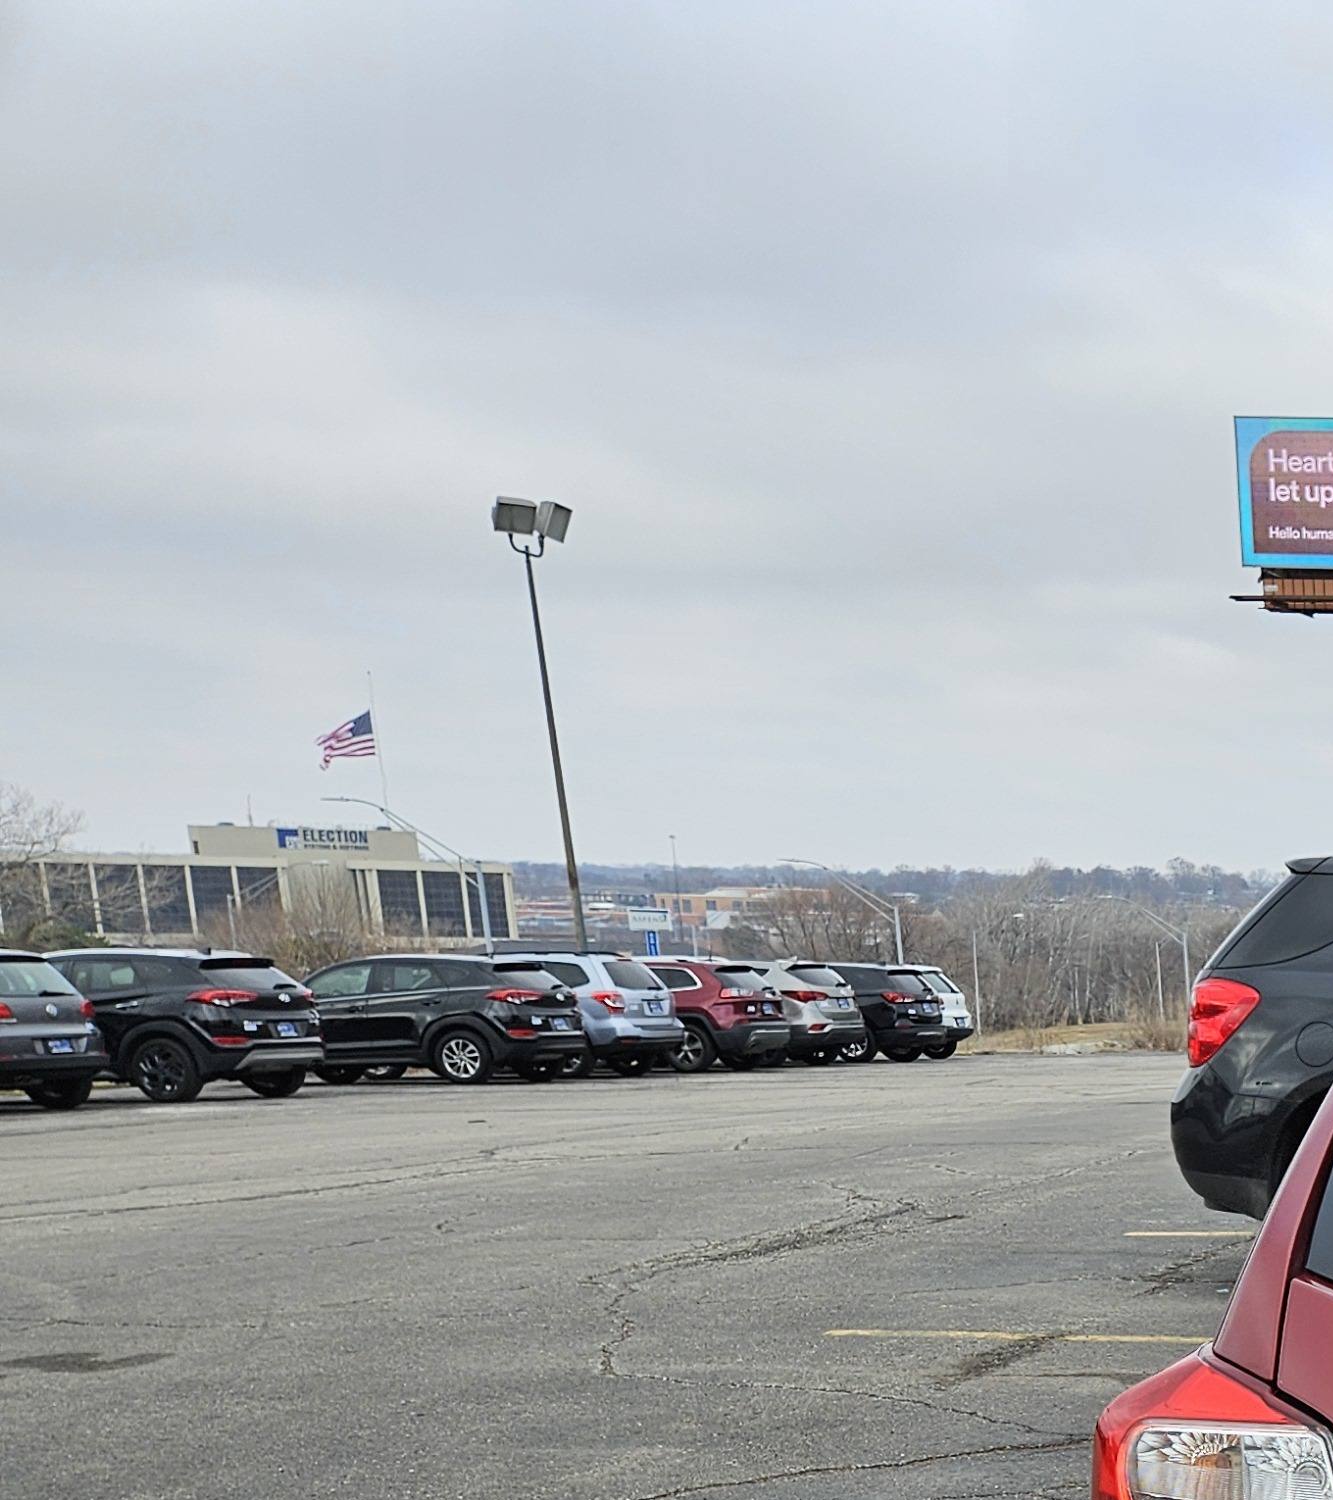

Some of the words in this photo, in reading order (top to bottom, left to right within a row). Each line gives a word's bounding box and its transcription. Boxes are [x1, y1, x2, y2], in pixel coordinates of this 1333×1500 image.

[1268, 477, 1301, 503] let
[1268, 526, 1300, 541] Hello
[303, 829, 369, 844] ELECTION
